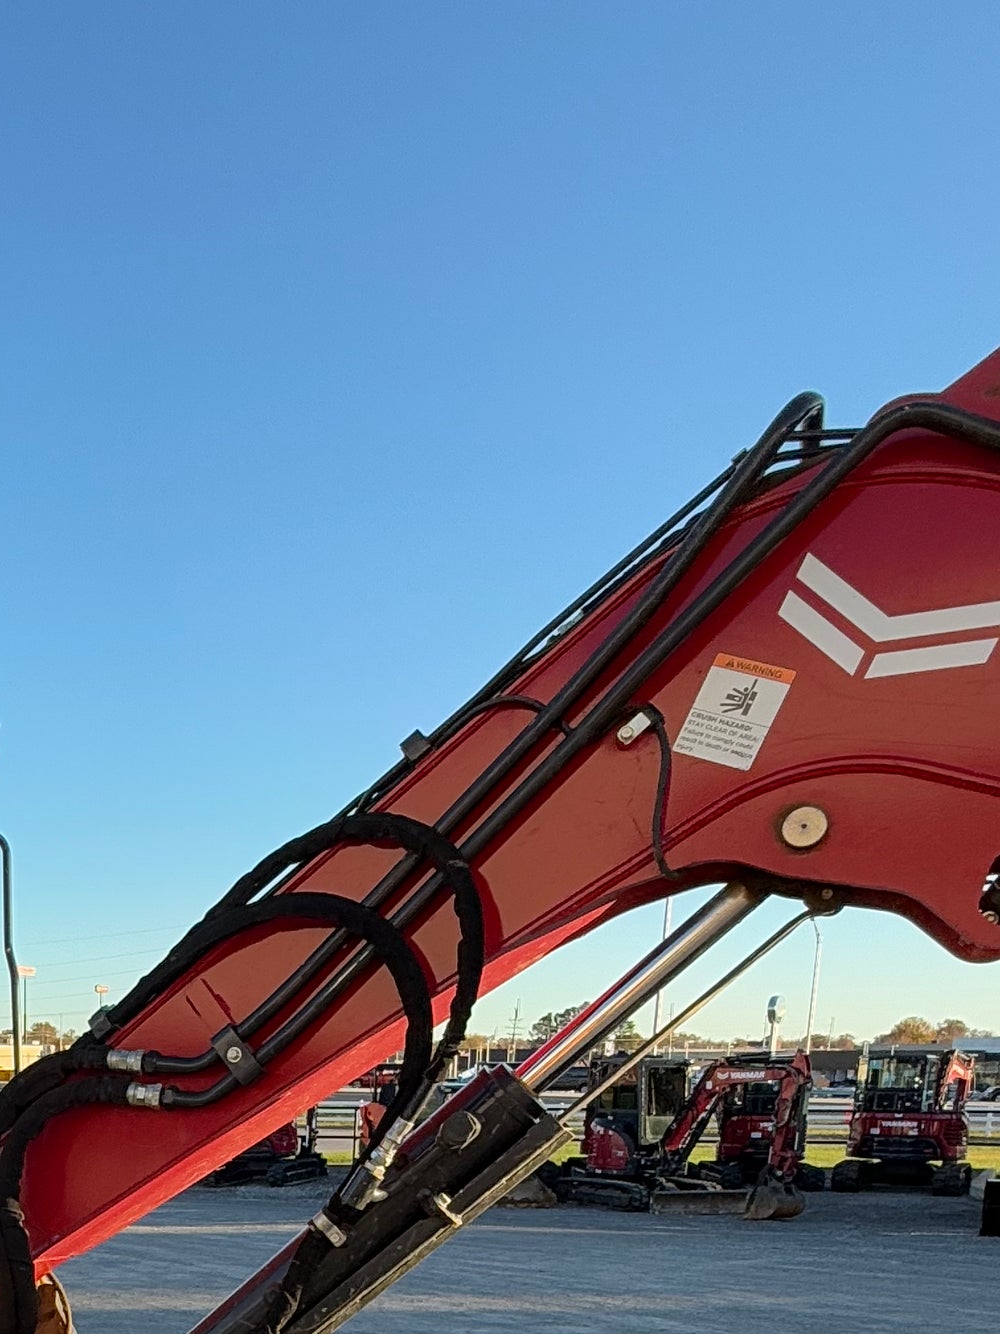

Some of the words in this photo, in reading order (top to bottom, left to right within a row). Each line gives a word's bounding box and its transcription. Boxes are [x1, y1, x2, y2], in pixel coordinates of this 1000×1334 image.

[736, 661, 783, 679] WARNING
[691, 711, 718, 722] CRUSH
[684, 727, 704, 737] Failure
[687, 719, 704, 729] STAY
[705, 723, 728, 735] CLEAR
[728, 729, 738, 737] OF
[730, 1071, 766, 1079] YANMAR
[881, 1120, 919, 1128] YANMAR
